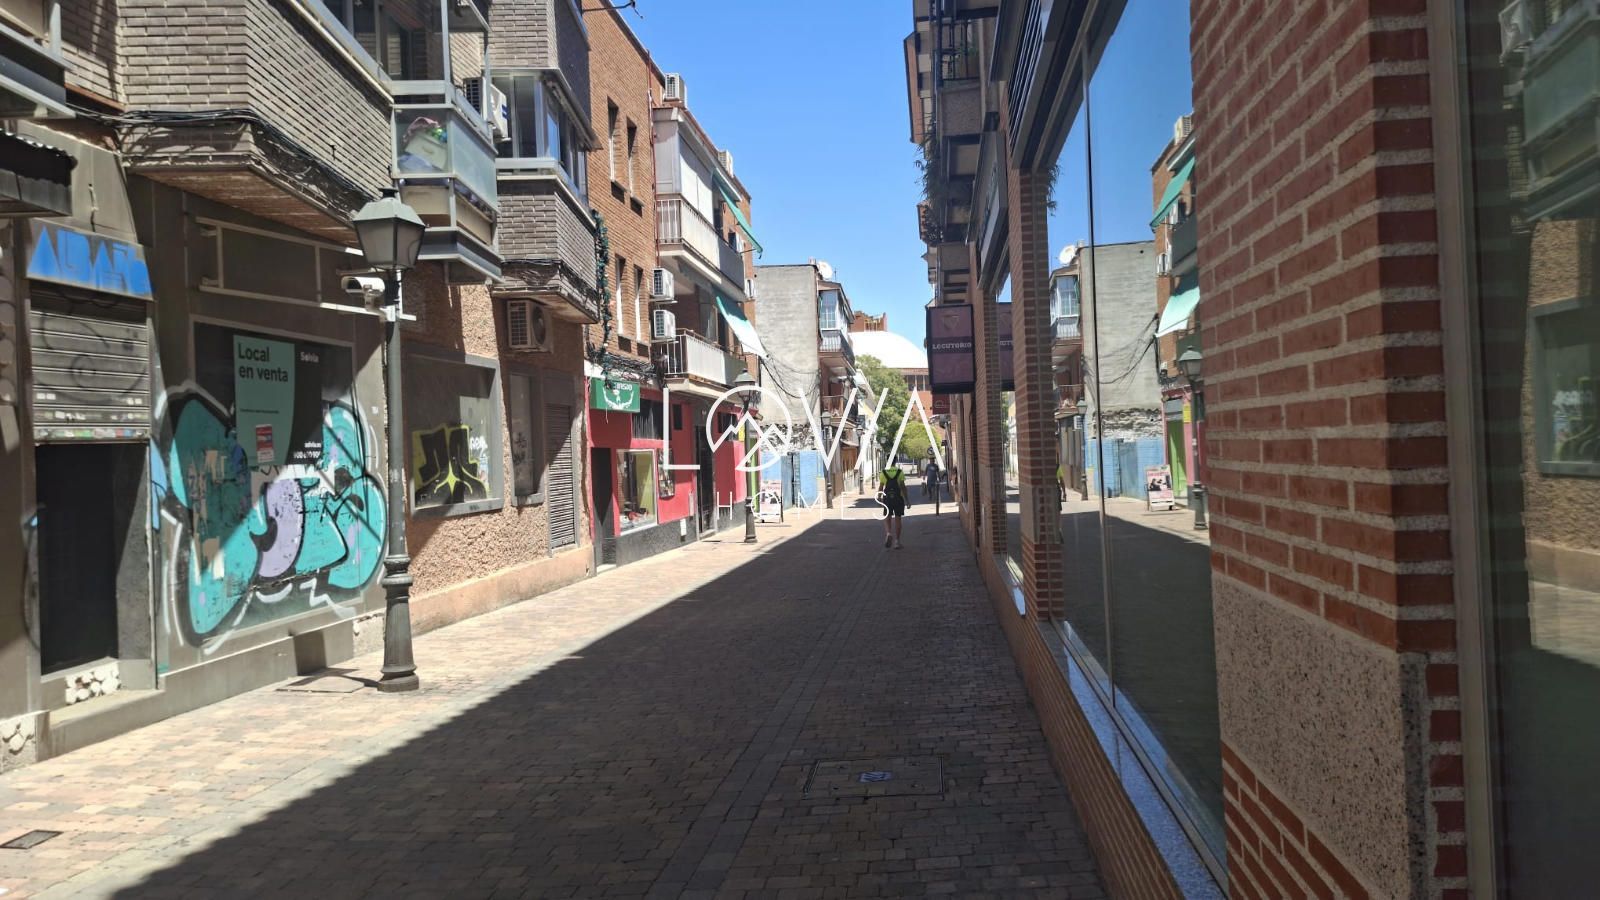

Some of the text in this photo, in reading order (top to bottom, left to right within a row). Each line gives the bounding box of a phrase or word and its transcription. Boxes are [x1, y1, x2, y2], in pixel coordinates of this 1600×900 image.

[238, 343, 270, 362] Local
[239, 365, 288, 382] en venta
